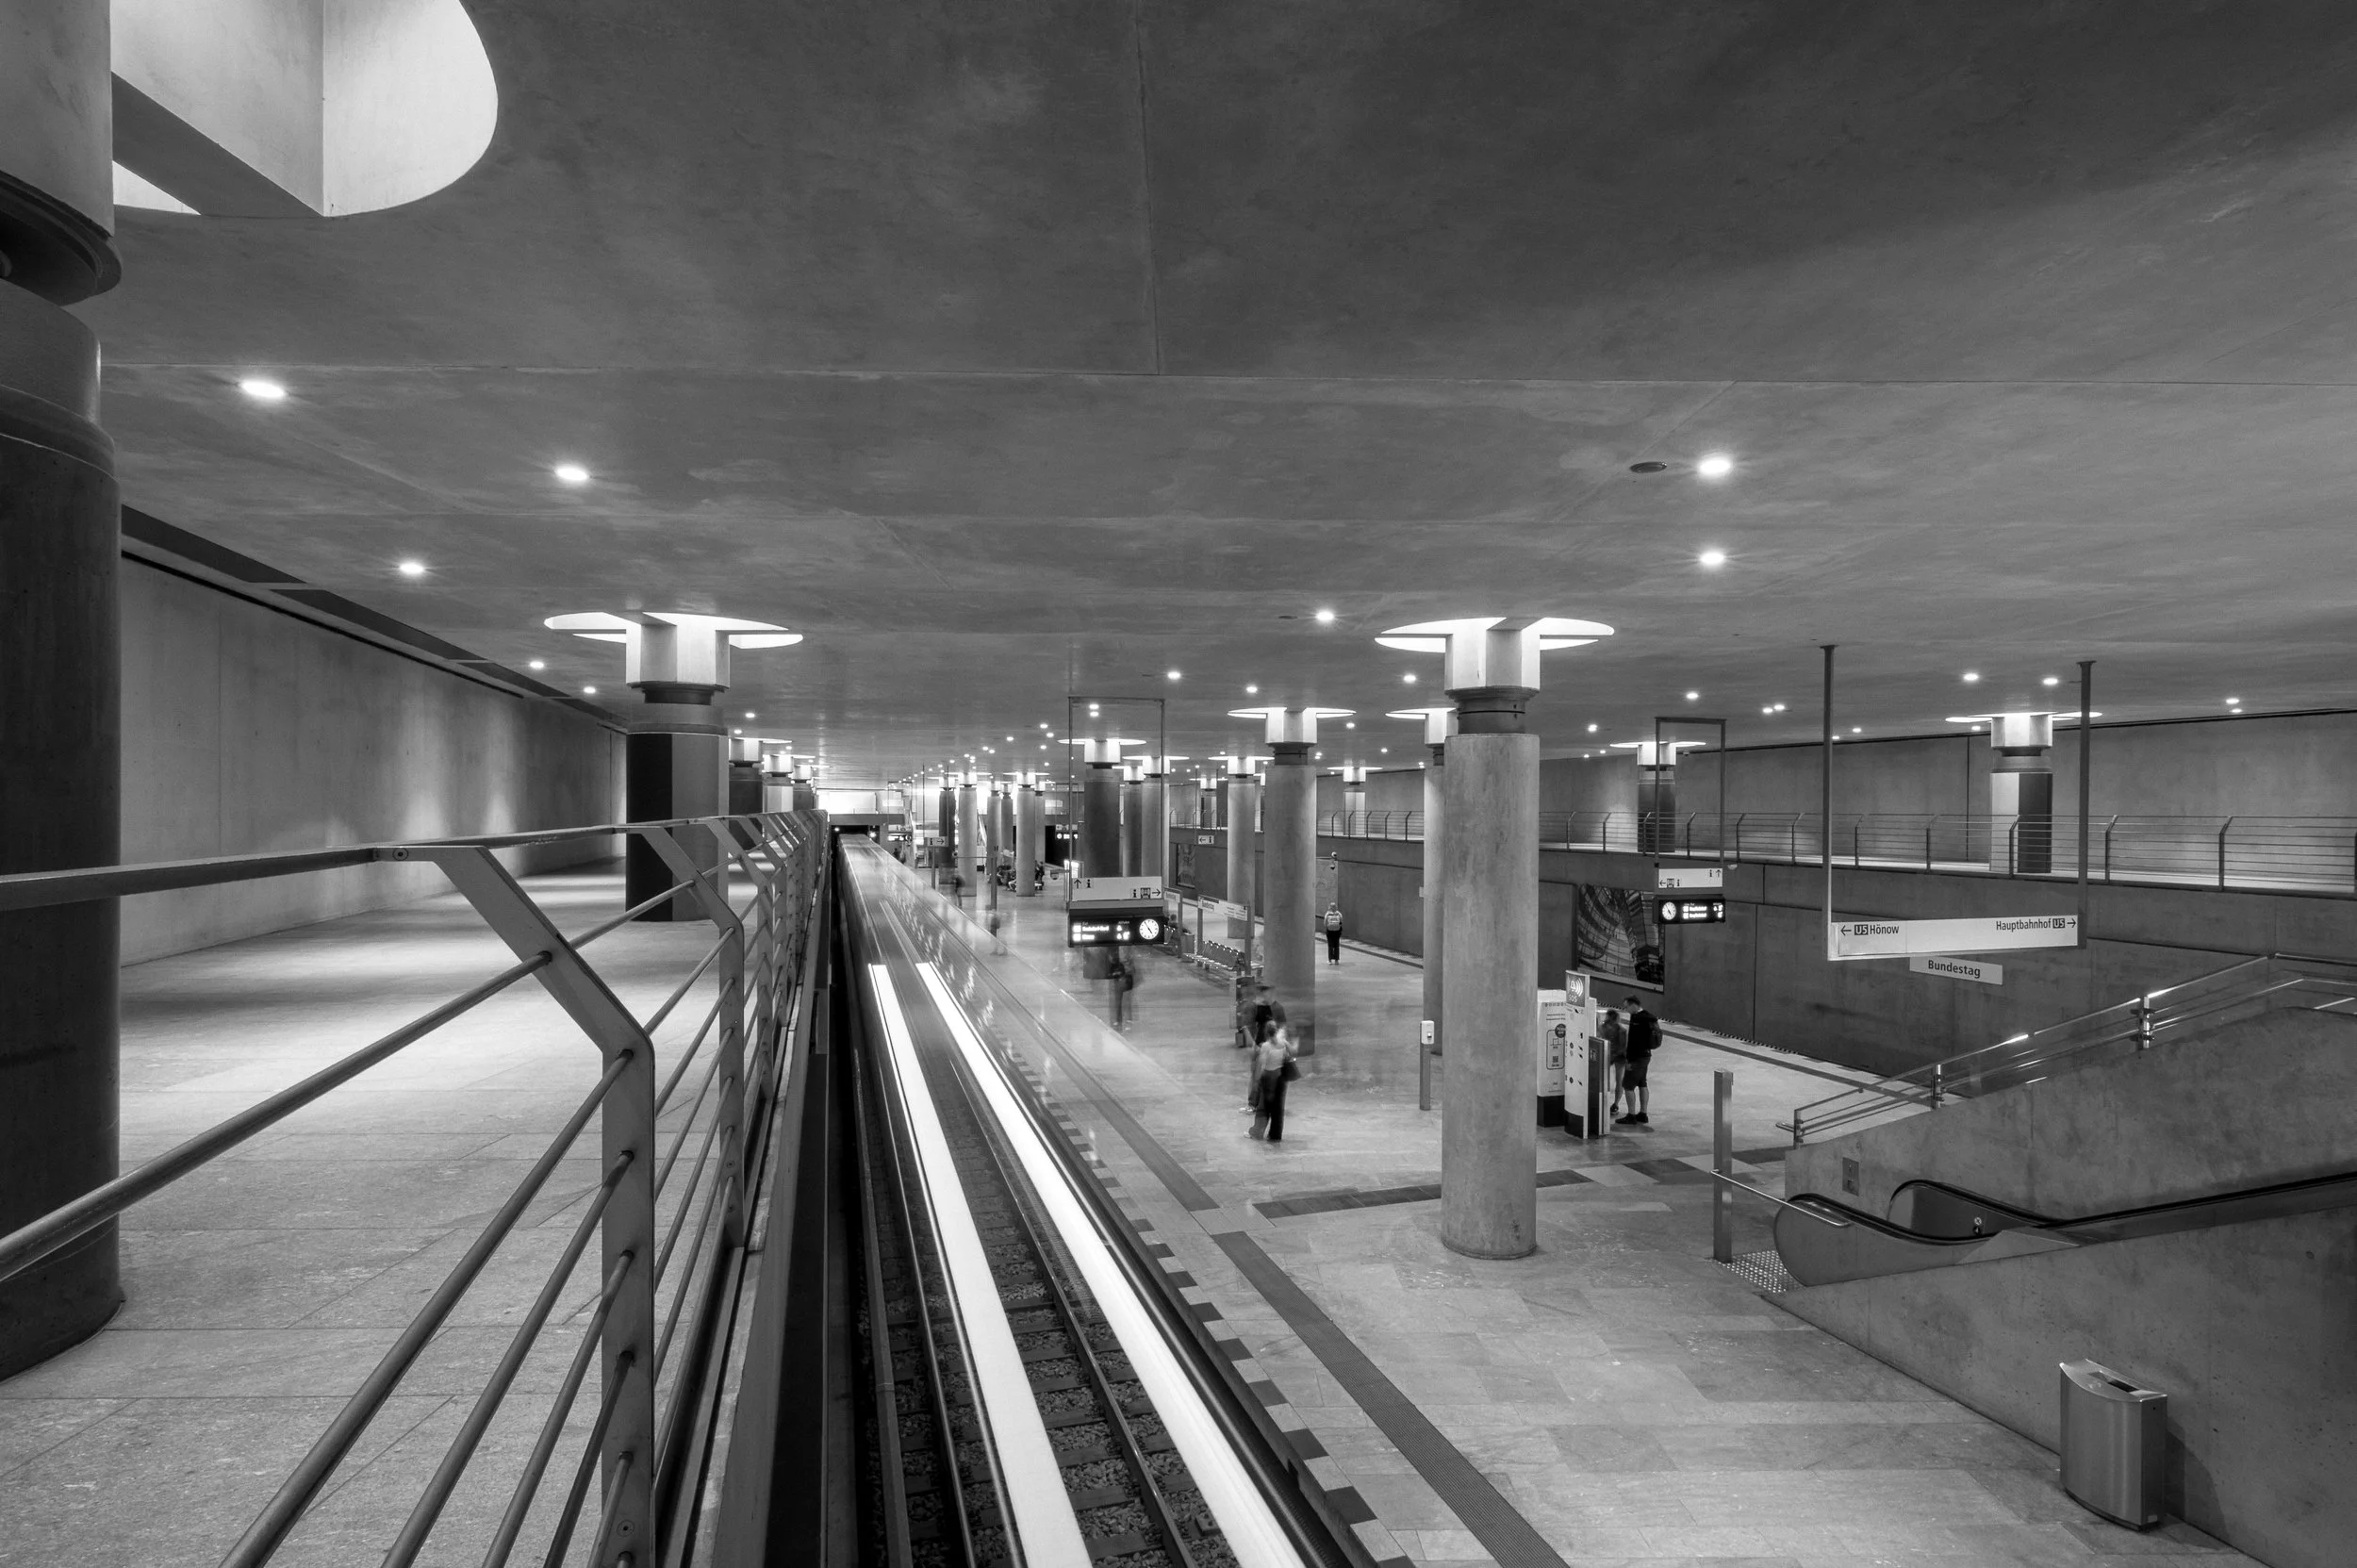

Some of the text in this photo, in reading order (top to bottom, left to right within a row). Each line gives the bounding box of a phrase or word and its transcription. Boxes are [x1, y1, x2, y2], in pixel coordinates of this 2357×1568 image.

[1855, 924, 1899, 935] U5 Hönow
[1996, 918, 2065, 933] Hauptbahnhof U5
[1928, 959, 1981, 979] Bundestag
[1568, 994, 1578, 1003] SOS
